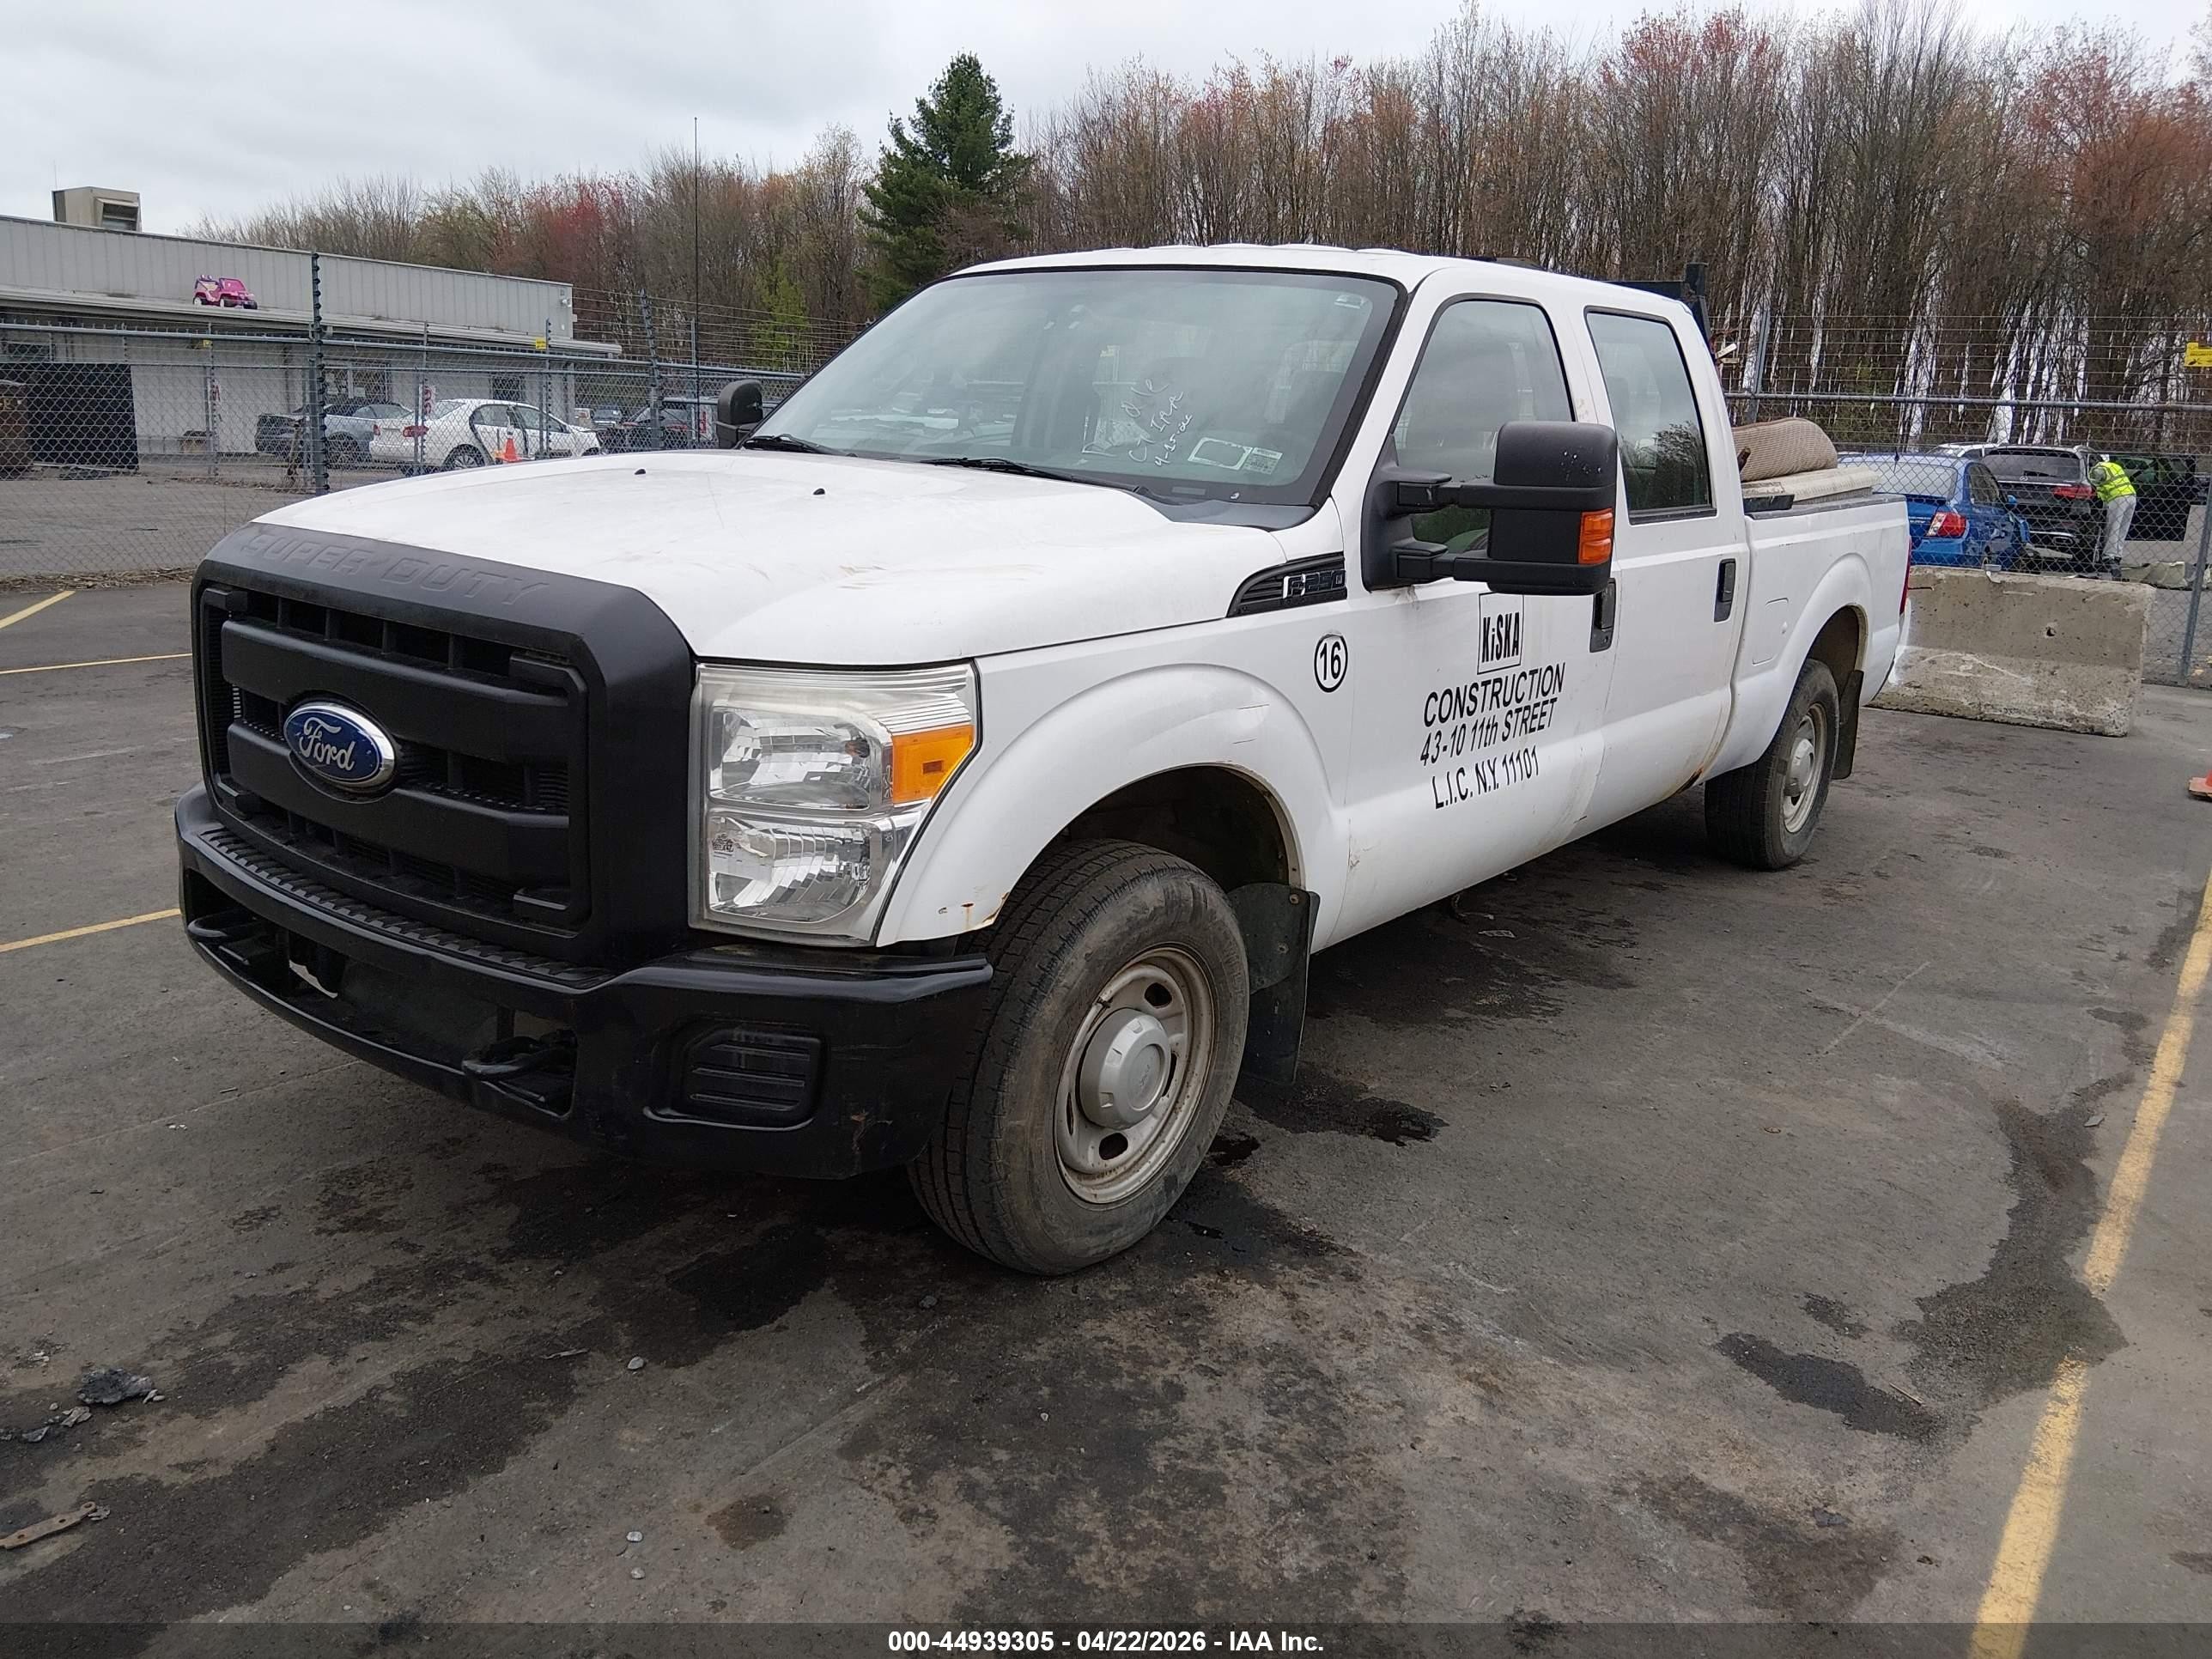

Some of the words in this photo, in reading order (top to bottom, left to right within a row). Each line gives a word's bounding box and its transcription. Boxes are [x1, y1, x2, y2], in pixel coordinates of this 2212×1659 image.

[240, 534, 375, 575] SUPER
[379, 557, 550, 605] DUTY
[1319, 640, 1341, 681] 16
[1423, 662, 1565, 727] CONSTRUCTION
[299, 716, 356, 771] Ford
[1419, 723, 1467, 766] 43-10
[1470, 714, 1498, 752] 11th
[1502, 697, 1558, 743] STREET
[1431, 767, 1474, 810] L.I.C.
[1502, 745, 1539, 787] 11101
